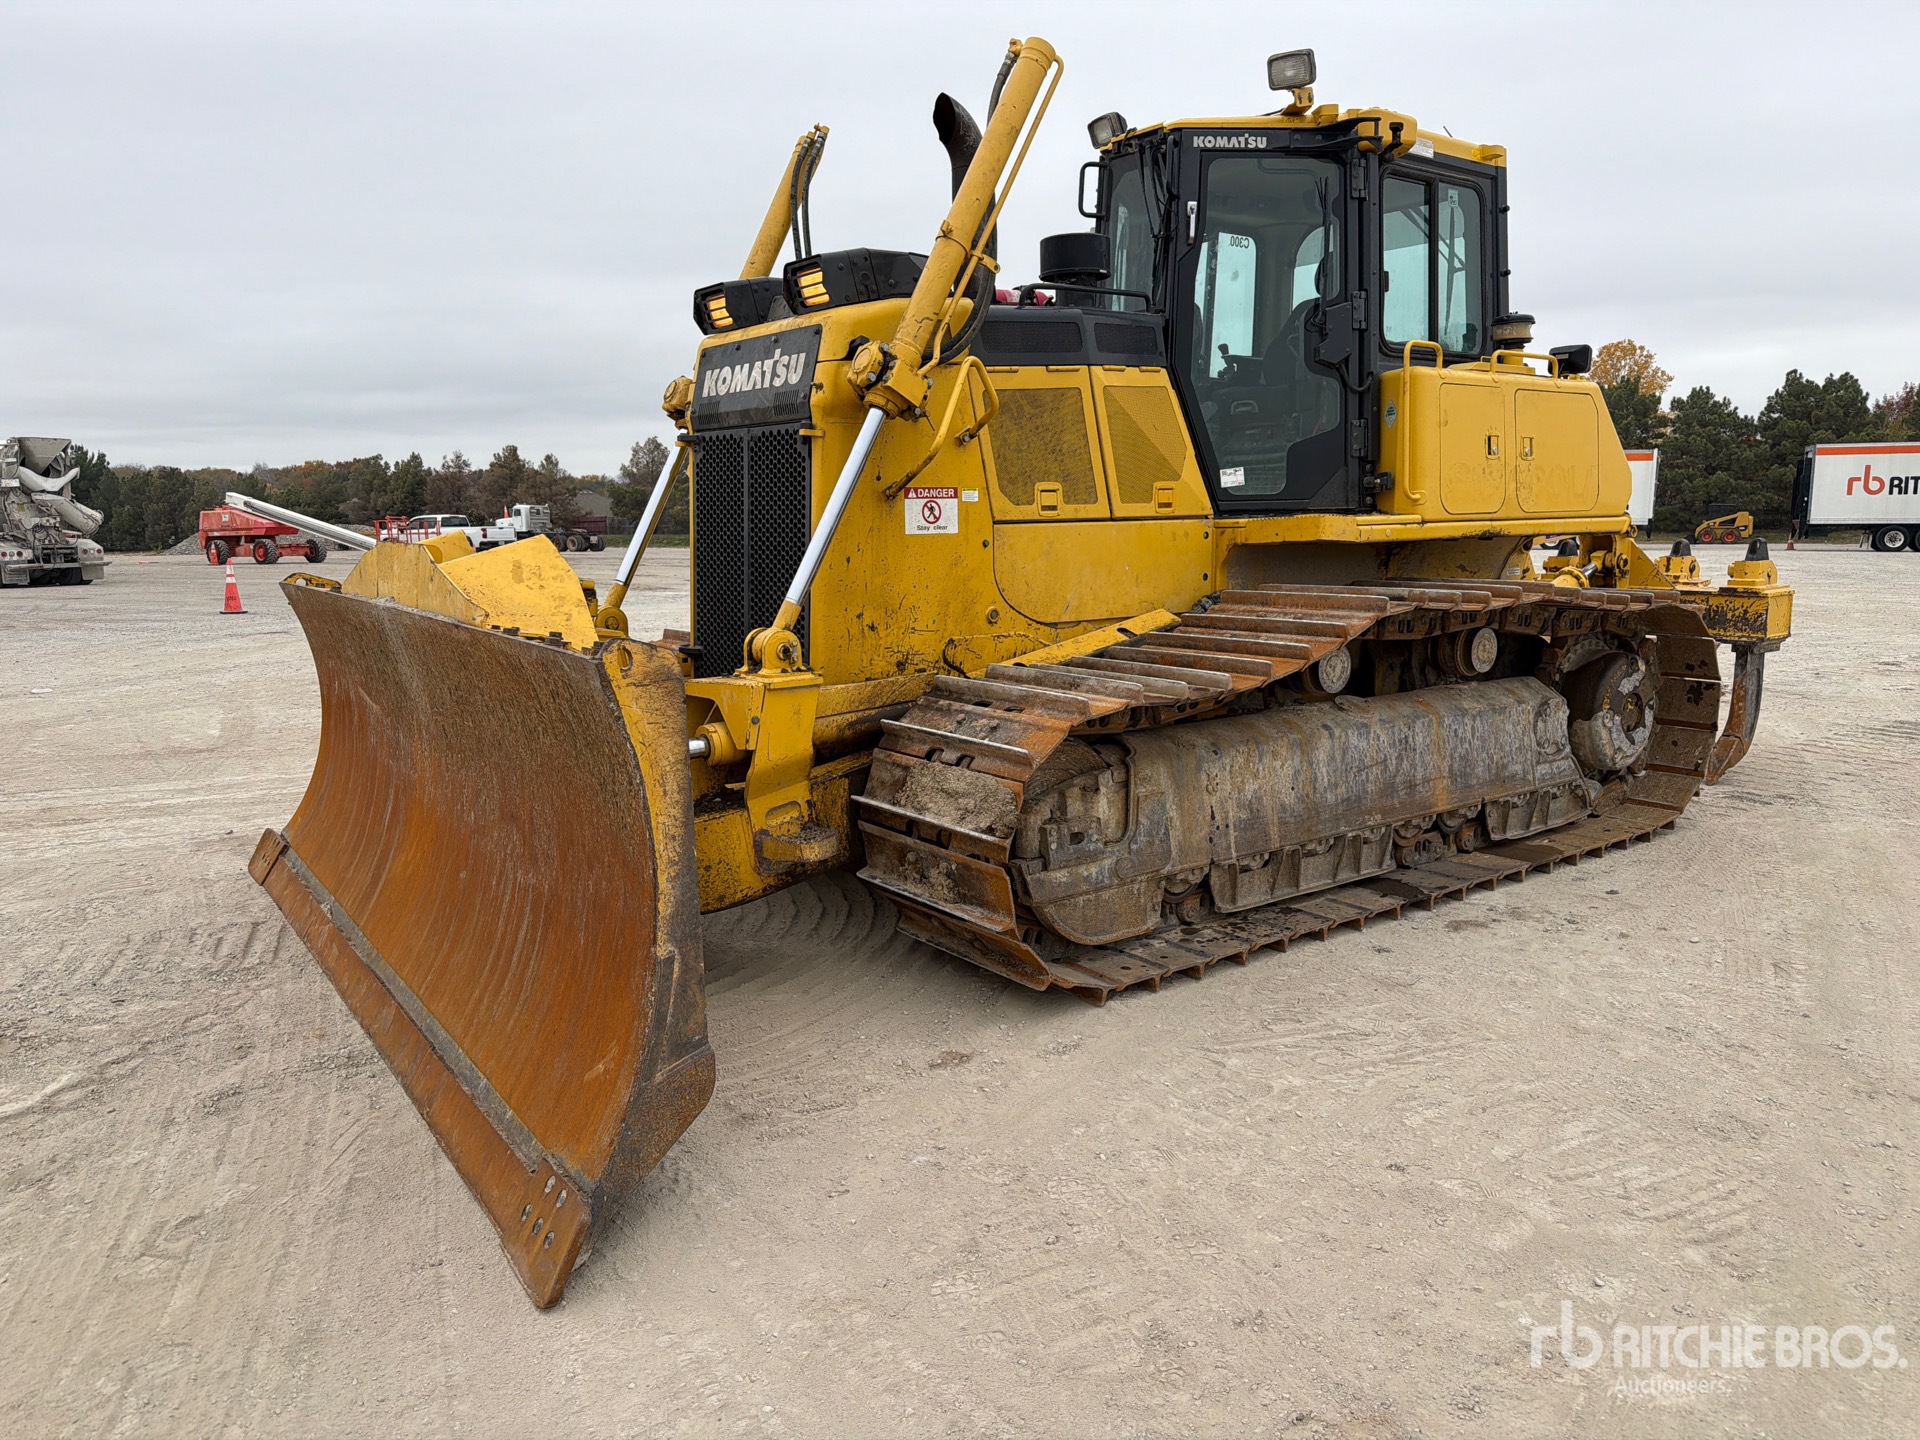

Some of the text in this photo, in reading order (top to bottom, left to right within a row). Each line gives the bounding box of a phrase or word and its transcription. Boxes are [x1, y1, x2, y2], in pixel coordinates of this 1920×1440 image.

[1193, 133, 1267, 148] KOMATSU
[702, 348, 806, 398] KOMATSU
[917, 488, 954, 498] DANGER
